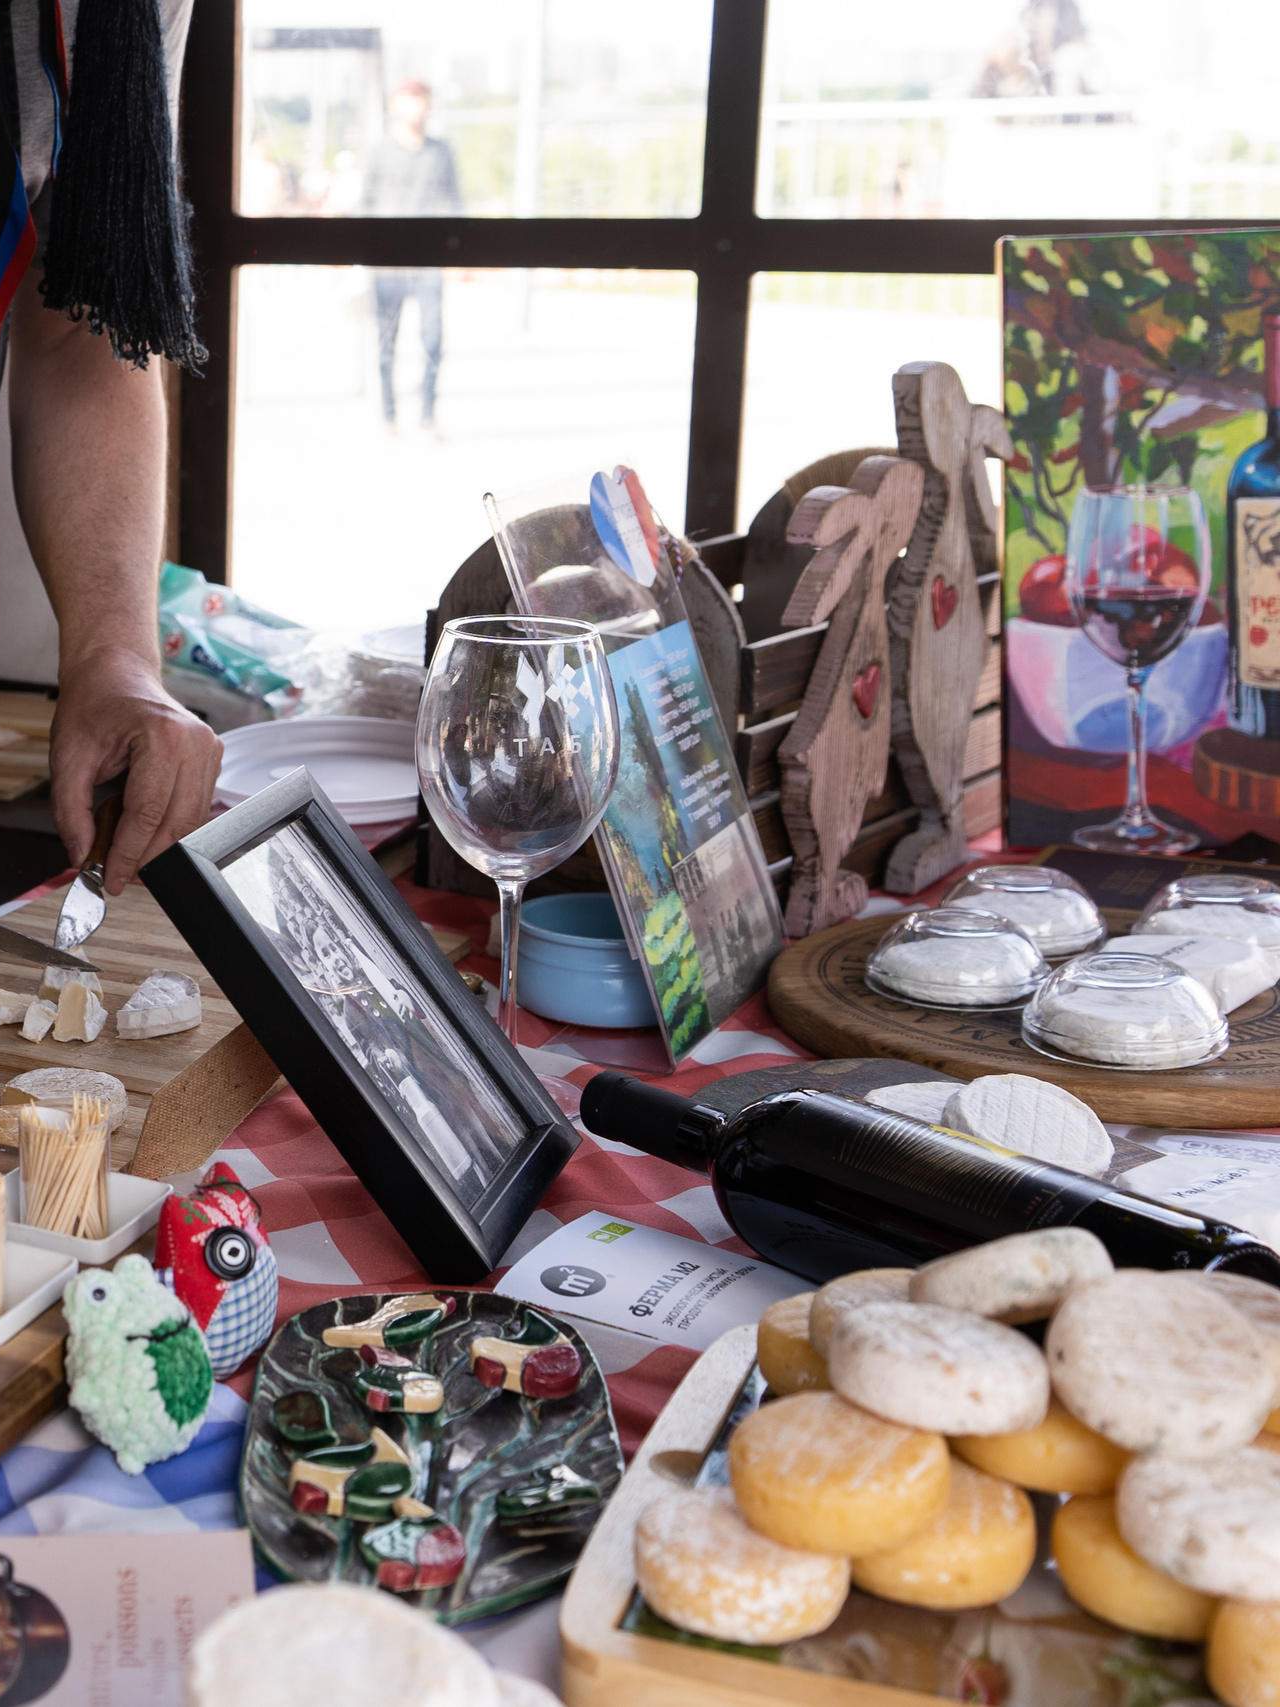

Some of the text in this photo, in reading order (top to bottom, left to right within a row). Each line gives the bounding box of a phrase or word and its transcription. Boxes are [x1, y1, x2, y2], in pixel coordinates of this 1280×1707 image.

[628, 1274, 683, 1317] ФЕРМА
[661, 1267, 730, 1327] ЭКОЛОГИЧЕСКИ ЧИСТЫЙ
[677, 1299, 709, 1331] ПРОДУКТ
[705, 1275, 737, 1301] НАПРЯМУЮ
[116, 1567, 147, 1668] poissons
